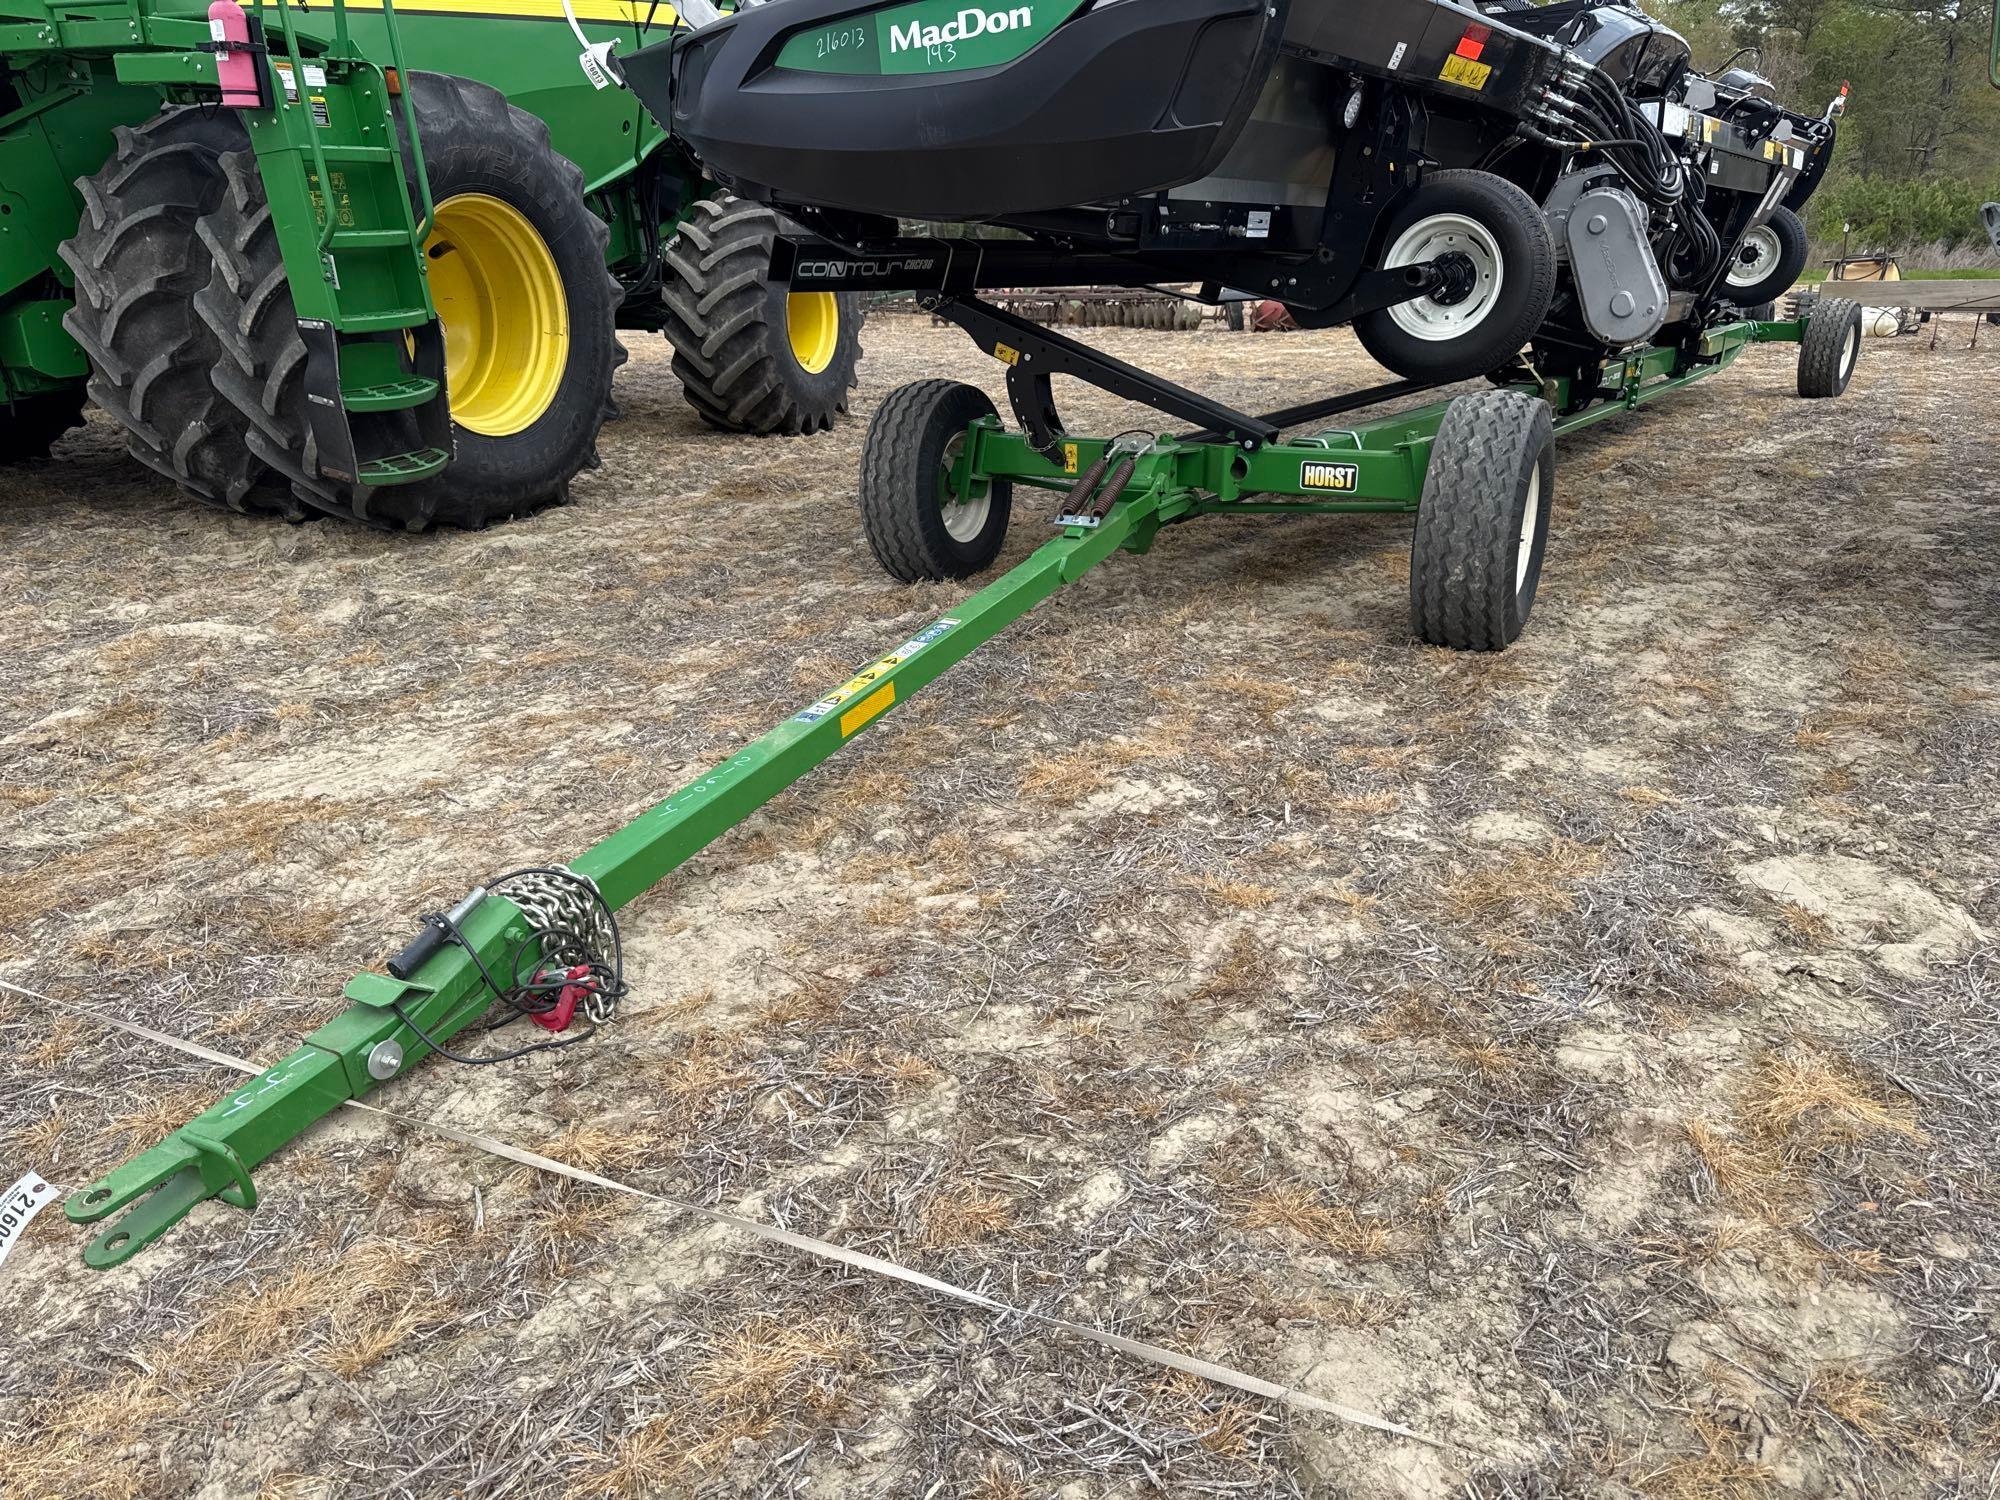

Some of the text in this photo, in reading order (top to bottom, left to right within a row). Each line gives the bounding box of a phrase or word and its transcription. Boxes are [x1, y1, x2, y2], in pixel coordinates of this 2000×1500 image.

[816, 27, 865, 59] 216013
[890, 6, 1031, 54] MacDon
[926, 43, 957, 66] 143
[1304, 465, 1355, 488] HORST
[0, 1193, 36, 1248] 2160
